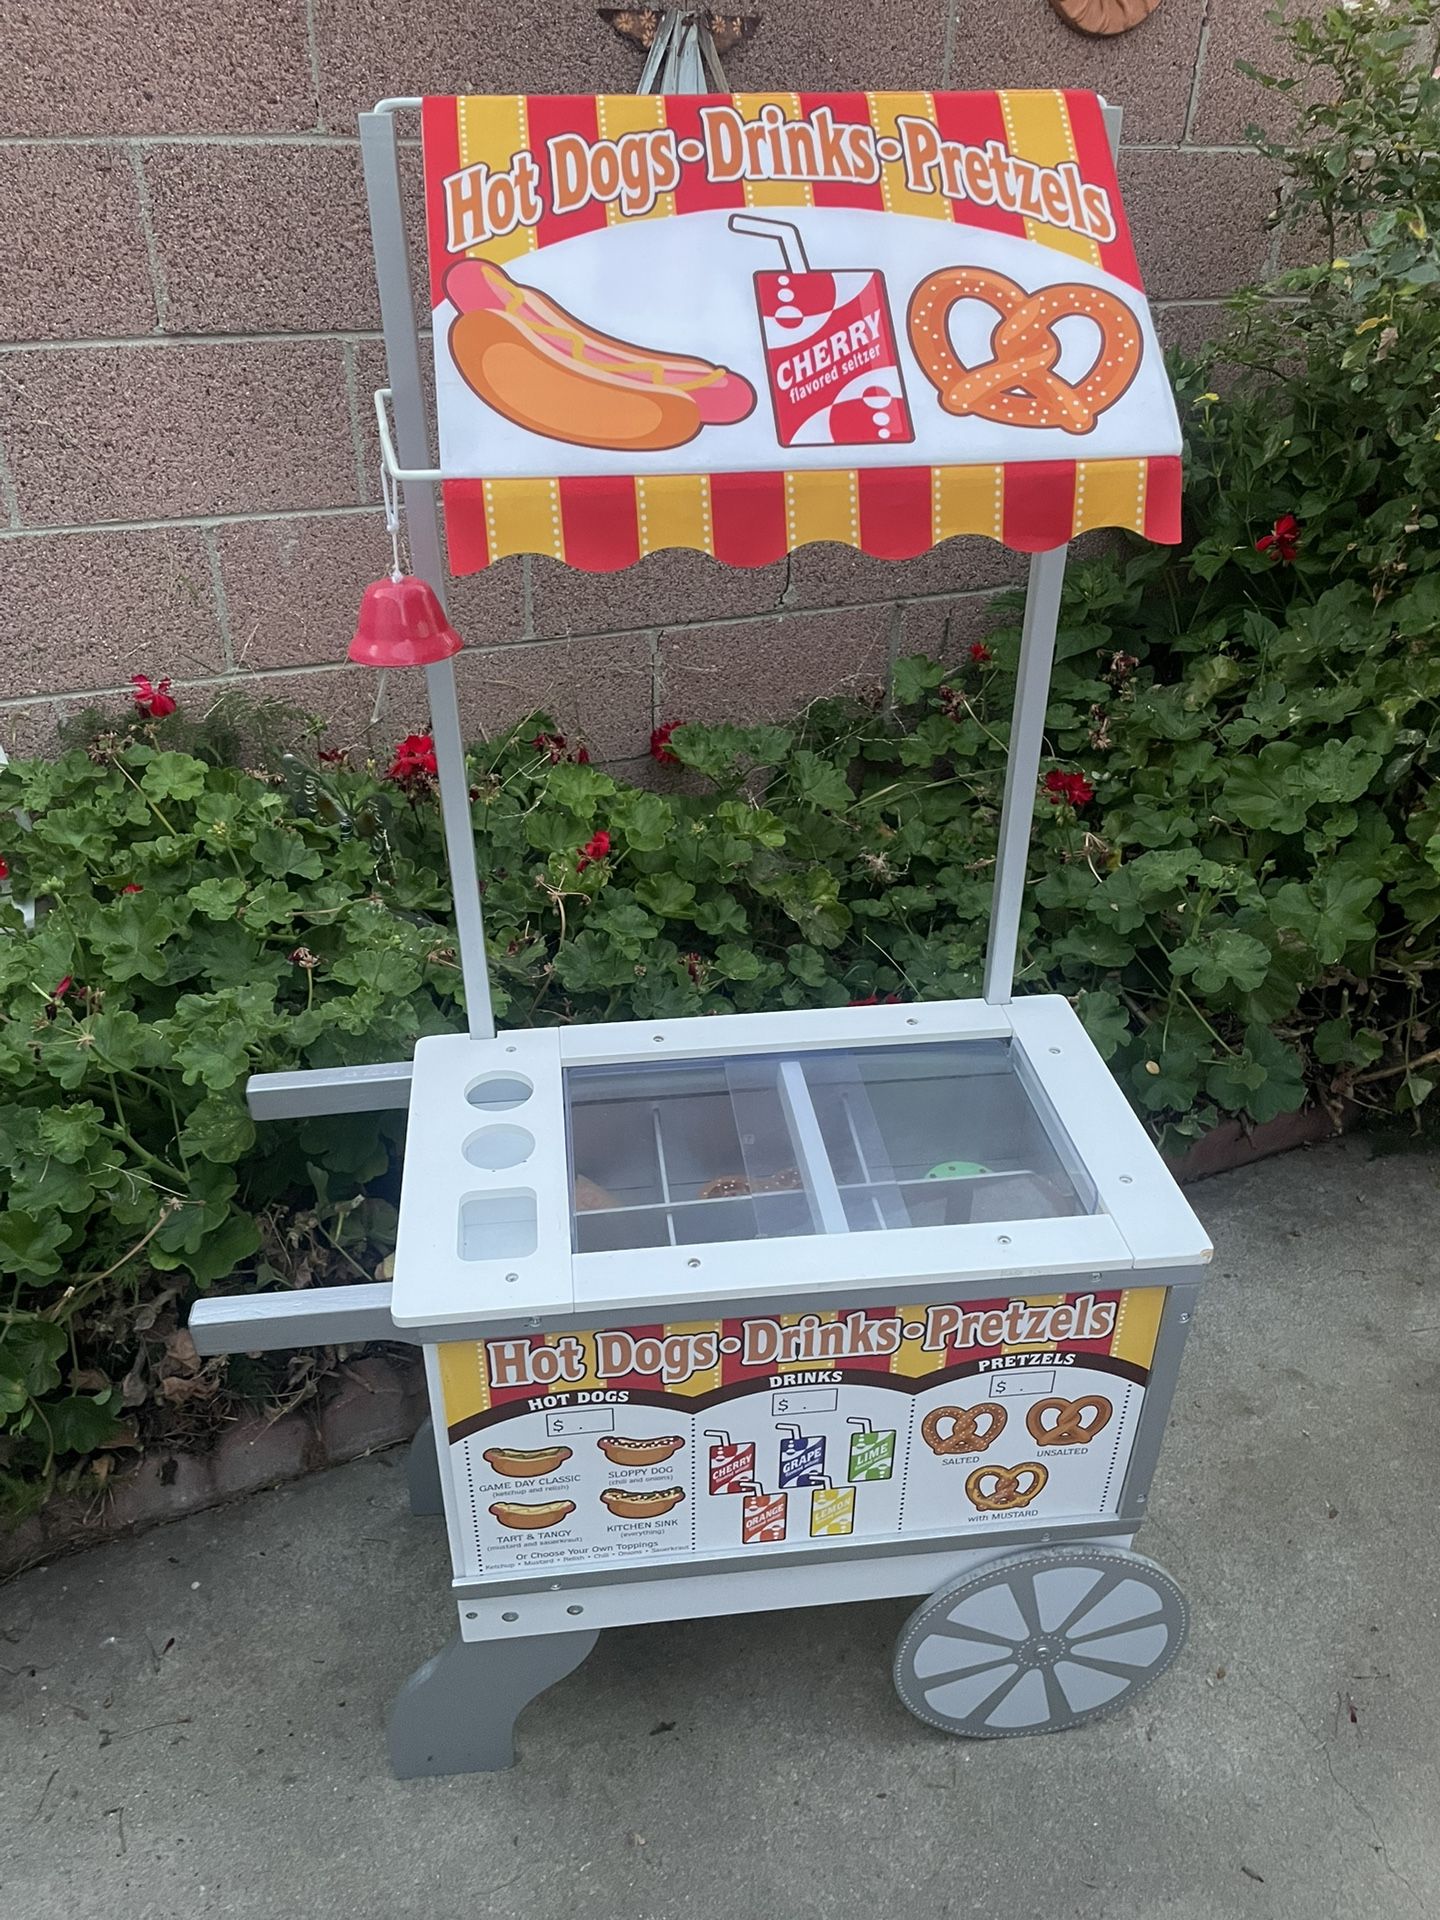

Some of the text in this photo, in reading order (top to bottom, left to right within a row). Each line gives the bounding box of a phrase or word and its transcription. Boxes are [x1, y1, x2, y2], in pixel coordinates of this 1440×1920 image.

[443, 103, 1117, 253] Hot Dogs Drinks Pretzels
[777, 309, 880, 390] CHERRY
[789, 344, 880, 404] flavored seltzer
[489, 1293, 1117, 1387] Hot Dogs Drinks Pretzels
[978, 1353, 1076, 1372] PRETZELS
[769, 1371, 843, 1388] DRINKS
[528, 1391, 630, 1411] HOT DOGS
[783, 1447, 821, 1473] GRAPE
[857, 1442, 888, 1466] LIME
[942, 1456, 980, 1466] SALTED
[1036, 1447, 1088, 1457] UNSALTED
[608, 1466, 673, 1479] SLOPPY DOG
[712, 1454, 752, 1480] CHERRY
[479, 1475, 581, 1492] GAME DAY CLASSIC
[746, 1503, 784, 1528] ORANGE
[815, 1497, 851, 1520] LEMON
[968, 1509, 1038, 1522] with MUSTARD
[607, 1519, 678, 1532] KITCHEN SINK
[621, 1529, 665, 1538] (everything)
[497, 1534, 523, 1543] TART
[538, 1530, 572, 1540] TANGY
[516, 1541, 658, 1561] Or Choose Your Own Toppings
